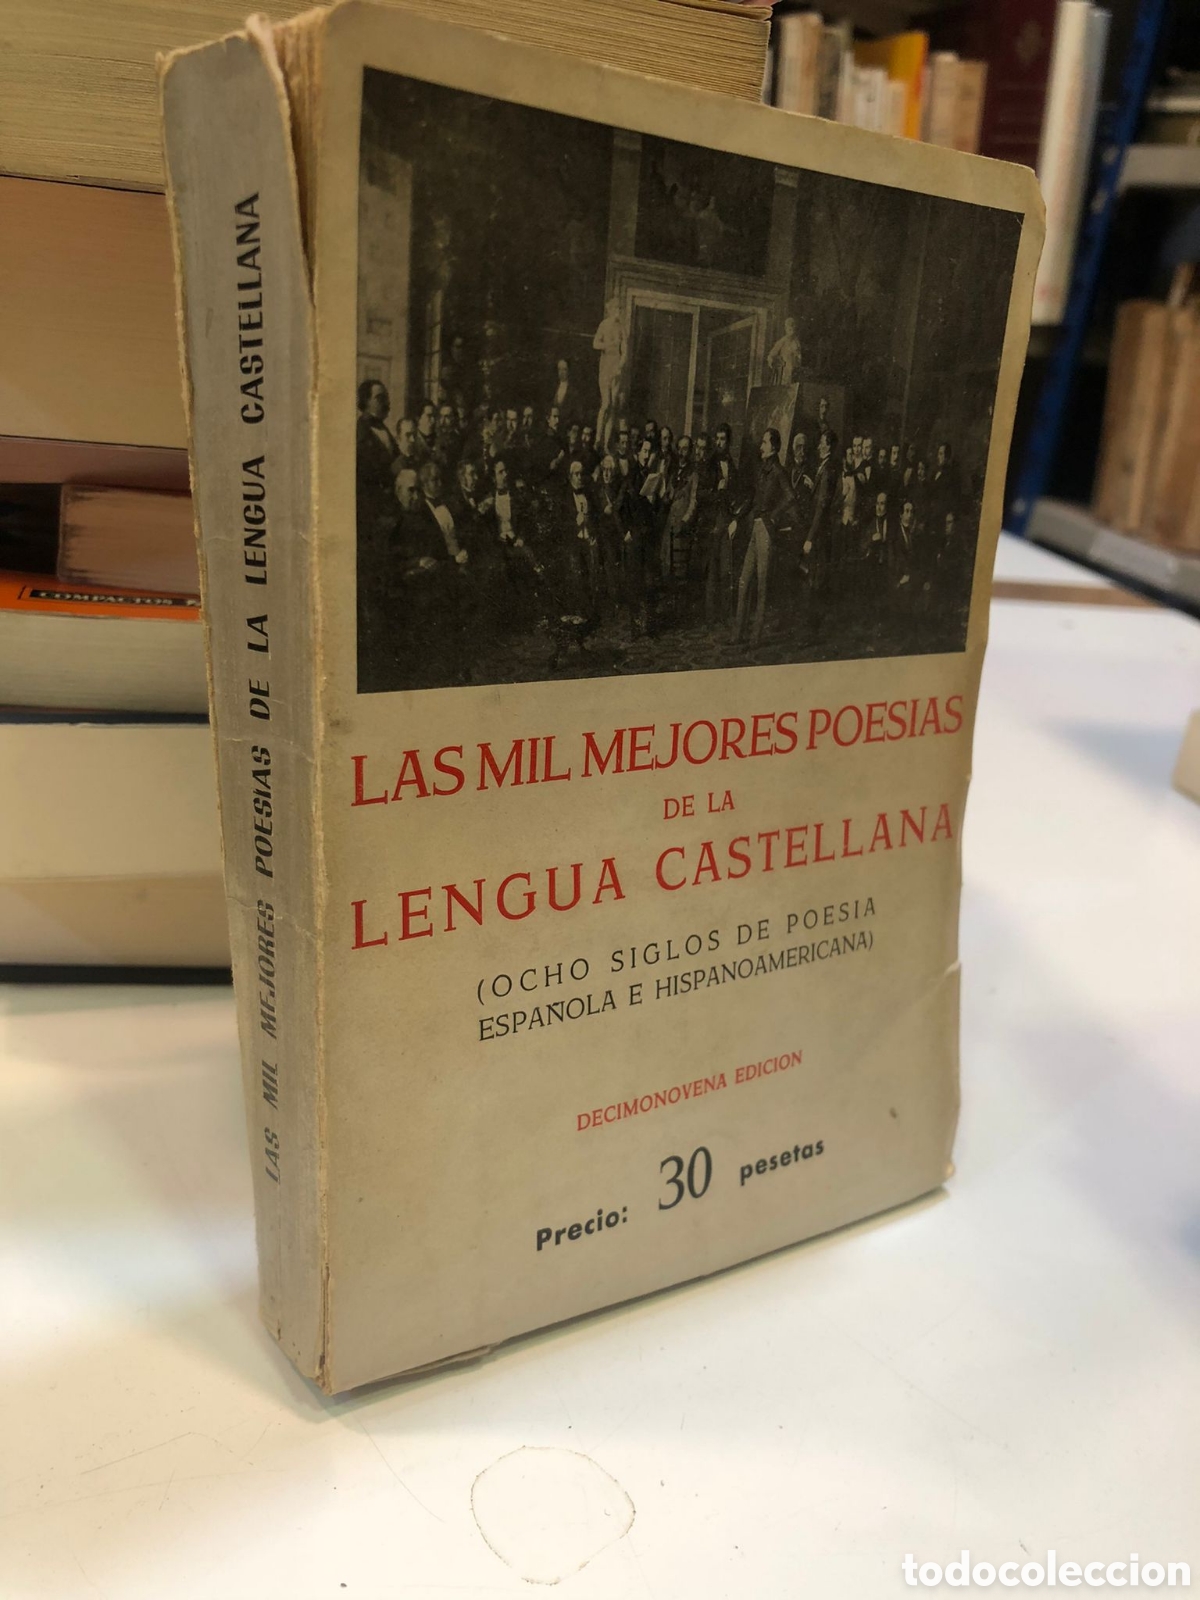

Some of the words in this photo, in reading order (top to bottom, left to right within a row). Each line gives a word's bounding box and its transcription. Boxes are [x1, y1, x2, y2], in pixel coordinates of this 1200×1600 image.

[233, 191, 266, 425] CASTELLANA
[242, 455, 268, 586] LENGUA
[246, 613, 270, 654] LA
[249, 678, 271, 721] DE
[350, 744, 467, 807] LAS
[475, 735, 572, 792] MIL
[581, 710, 800, 779] MEJORES
[804, 694, 965, 752] POESIAS
[250, 745, 274, 879] POESIAS
[662, 794, 696, 821] DE
[706, 789, 736, 814] LA
[350, 856, 627, 950] LENGUA
[654, 802, 955, 892] CASTELLANA
[256, 899, 277, 1040] MEJORES
[476, 957, 591, 1007] (OCHO
[610, 929, 721, 973] SIGLOS
[736, 918, 771, 946] DE
[786, 897, 877, 934] POESIA
[478, 989, 617, 1042] ESPAÑOLA
[628, 982, 644, 1007] E
[655, 930, 874, 1000] HISPANOAMERICANA)
[261, 1060, 279, 1112] MIL
[576, 1072, 728, 1132] DECIMONOVENA
[734, 1049, 804, 1085] EDICION
[264, 1127, 281, 1185] LAS
[535, 1205, 629, 1252] Precio:
[657, 1145, 713, 1212] 30
[739, 1138, 825, 1186] pesetas
